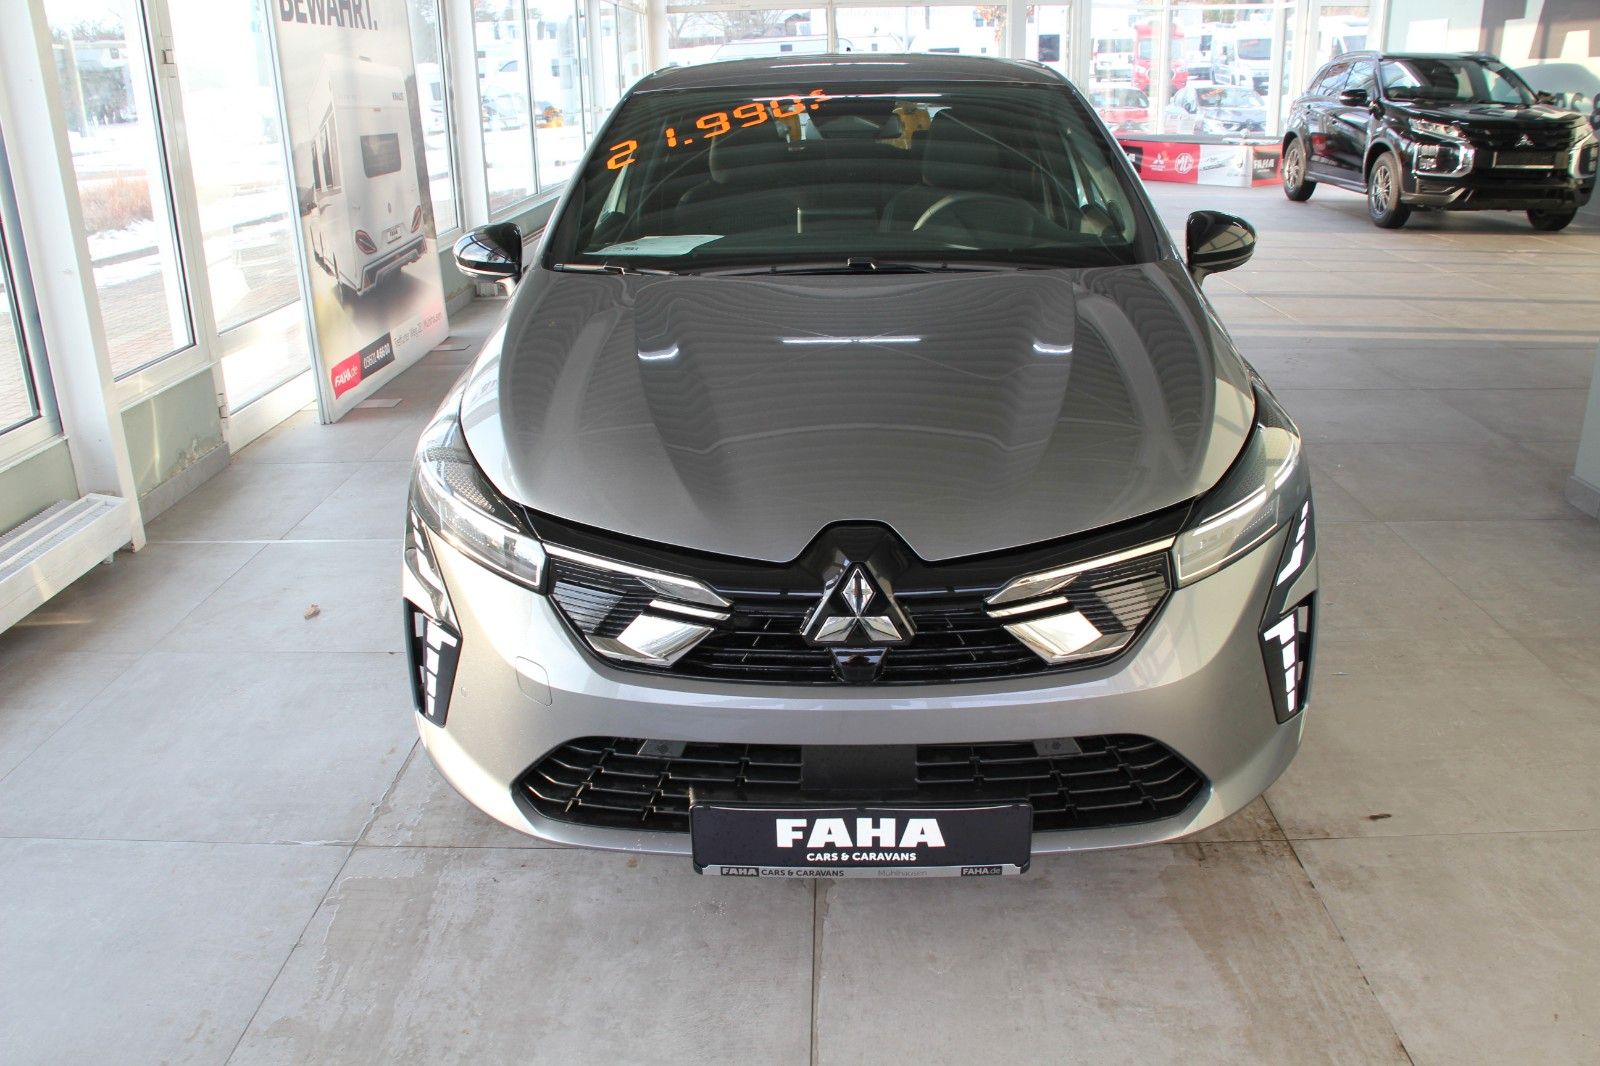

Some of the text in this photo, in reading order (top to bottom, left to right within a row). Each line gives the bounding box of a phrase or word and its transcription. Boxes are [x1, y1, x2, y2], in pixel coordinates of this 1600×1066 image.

[776, 817, 946, 848] FAHA
[806, 852, 917, 861] CARS & CARAVANS
[722, 867, 757, 875] FAHA
